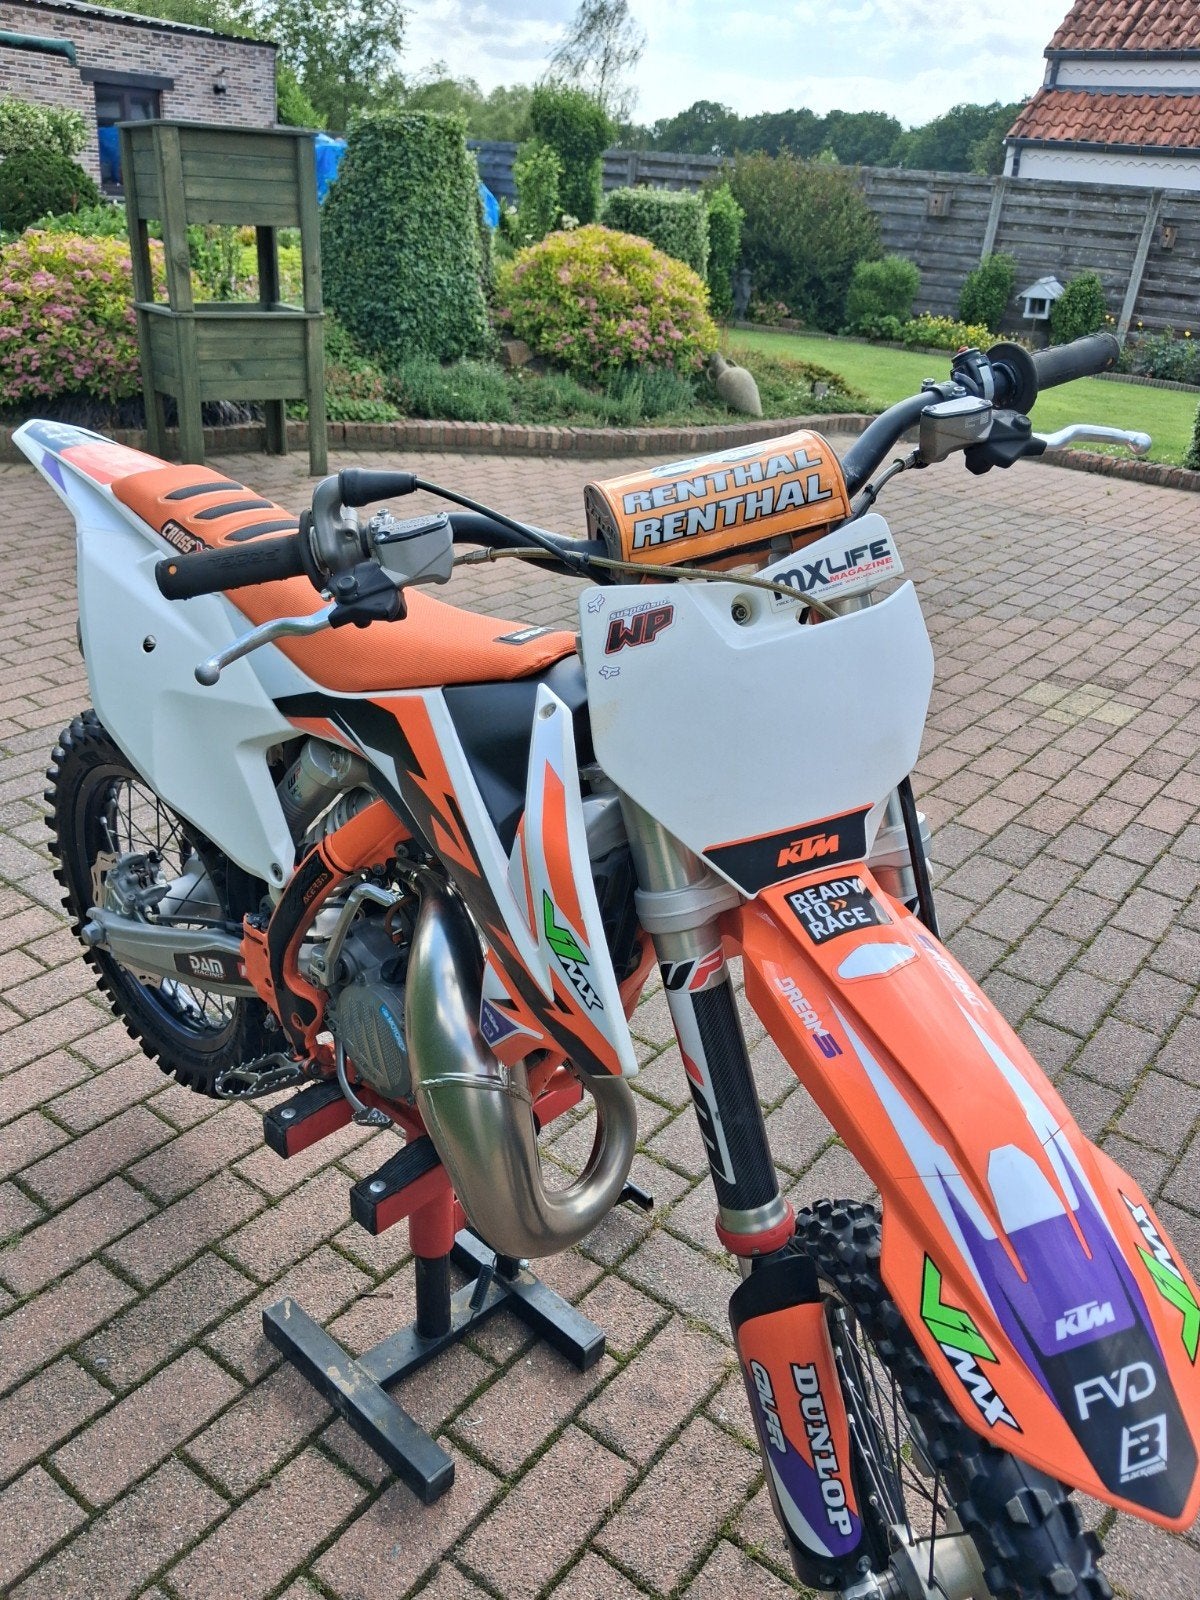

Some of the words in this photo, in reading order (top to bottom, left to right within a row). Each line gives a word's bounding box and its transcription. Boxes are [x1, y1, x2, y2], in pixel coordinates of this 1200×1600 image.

[622, 449, 822, 515] RENTHAL
[633, 474, 833, 550] RENTHAL
[829, 556, 893, 583] MAGAZINE
[604, 604, 675, 656] WP
[776, 833, 840, 868] KTM
[789, 877, 862, 911] READY
[800, 901, 833, 924] TO
[808, 907, 872, 940] RACE
[188, 955, 225, 974] DAM
[194, 968, 226, 979] RACING
[1055, 1300, 1116, 1342] KTM
[1073, 1361, 1158, 1422] FVD
[789, 1361, 853, 1537] DUNLOP
